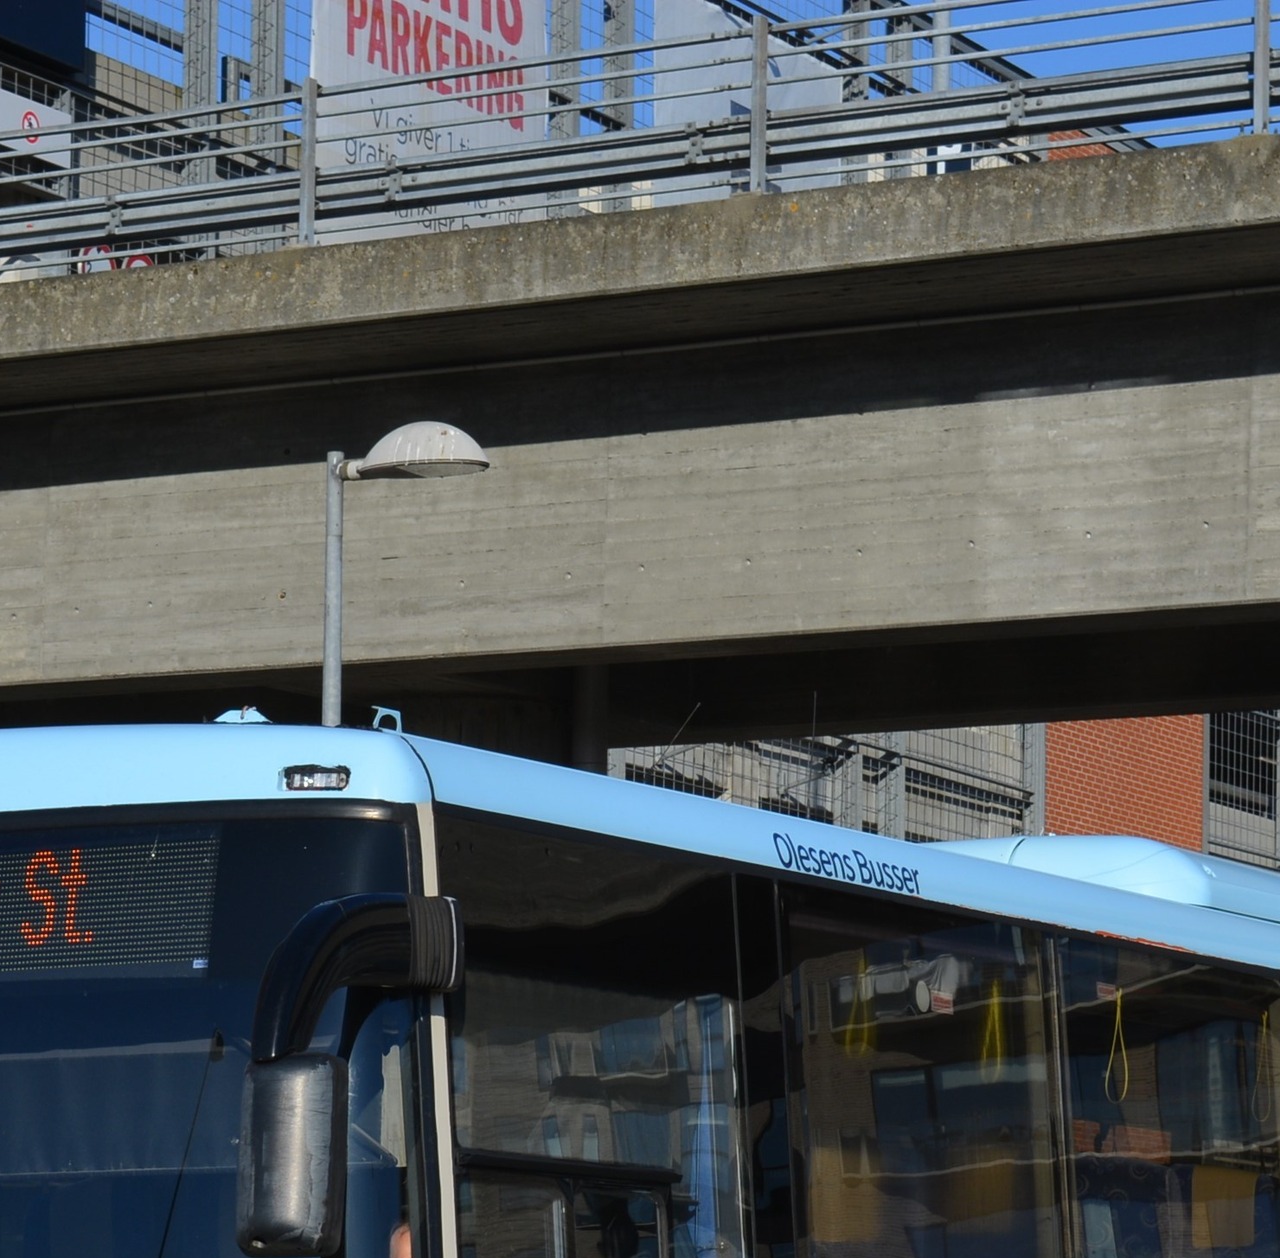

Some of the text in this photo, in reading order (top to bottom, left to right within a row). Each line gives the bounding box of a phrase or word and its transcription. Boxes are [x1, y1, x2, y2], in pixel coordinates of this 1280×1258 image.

[21, 849, 93, 946] St.
[773, 832, 920, 895] Olesens Busser
